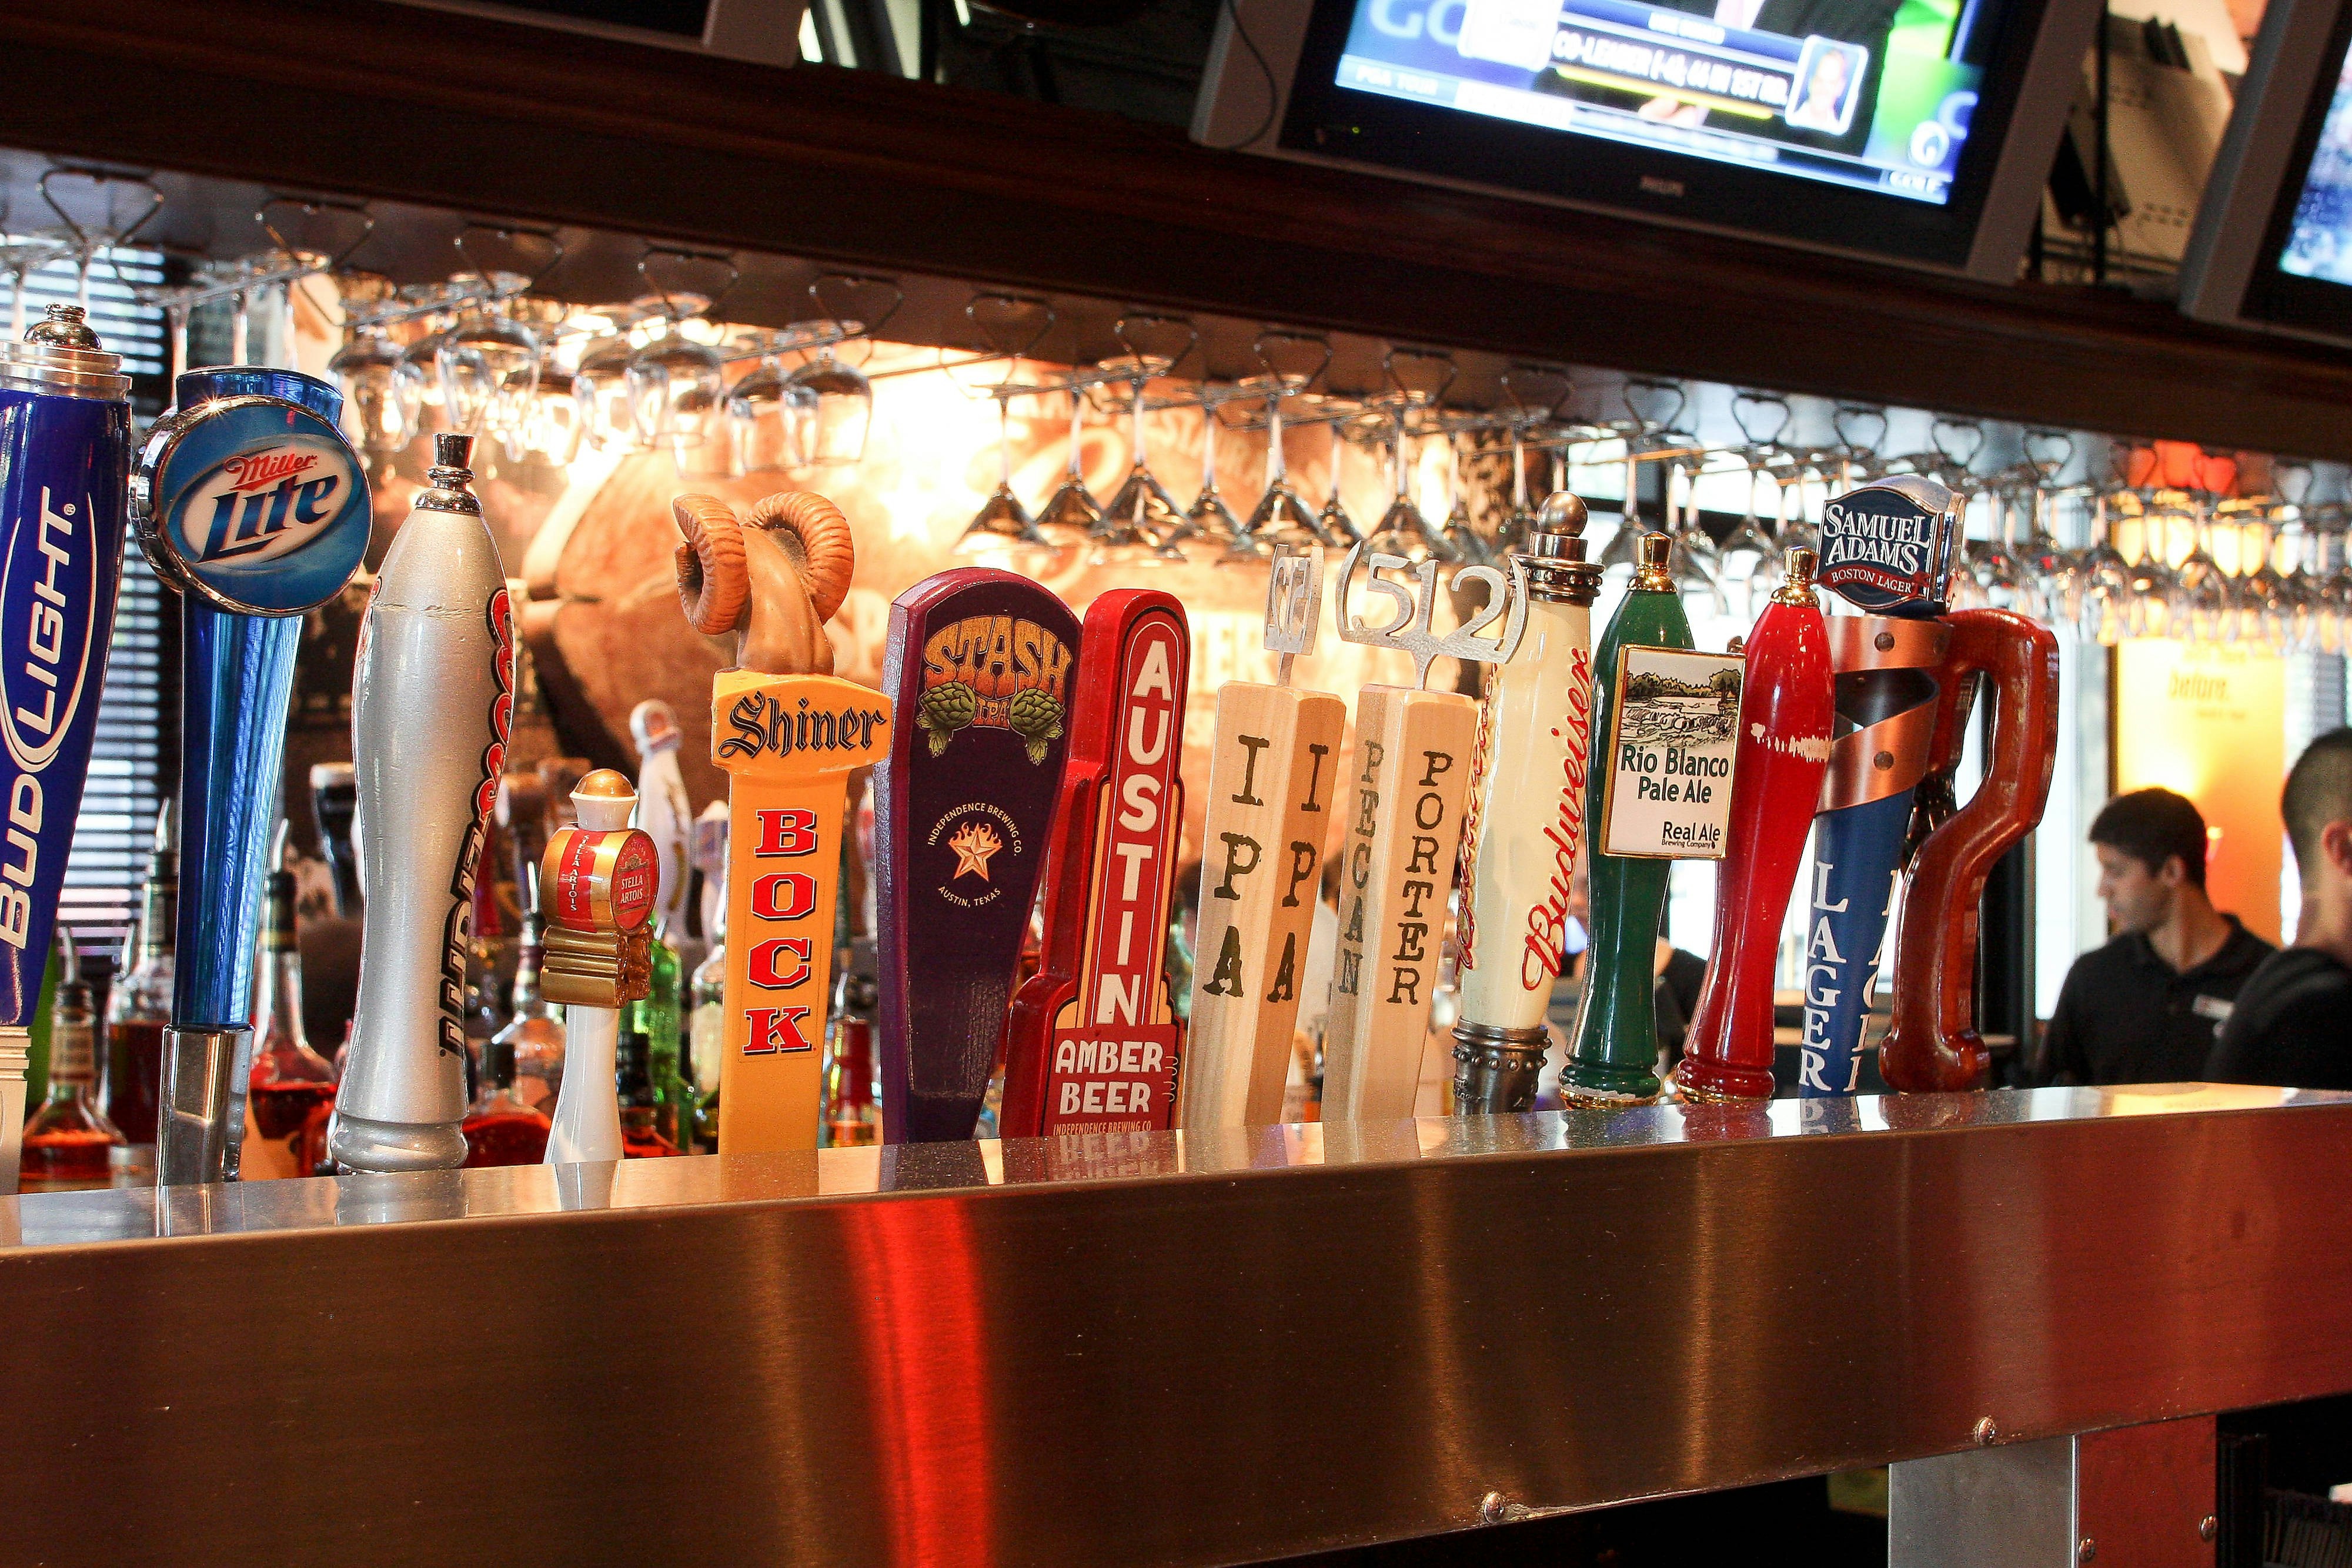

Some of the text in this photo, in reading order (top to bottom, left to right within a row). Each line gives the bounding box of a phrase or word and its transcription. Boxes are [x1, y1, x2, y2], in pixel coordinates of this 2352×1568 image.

[223, 453, 318, 486] Miller
[196, 474, 340, 563] Lite
[1823, 504, 1930, 549] SAMUEL
[1825, 536, 1919, 574] ADAMS
[1335, 540, 1529, 664] (512)
[1831, 568, 1912, 594] BOSTON LAGER
[924, 615, 1073, 706] STASH
[0, 486, 74, 950] BUD LIGHT
[718, 690, 888, 759] Shiner
[973, 696, 1010, 730] IPA
[1621, 745, 1729, 777] Rio Blanco
[1638, 776, 1712, 803] Pale Ale
[928, 803, 1022, 856] INDEPENDENCE BREWING CO.
[1097, 640, 1172, 1027] AUSTIN
[1521, 648, 1591, 991] Budweiser
[1661, 840, 1685, 848] Brewing
[1662, 821, 1720, 841] Real Ale
[569, 835, 589, 911] STELLA ARTOIS
[621, 875, 643, 890] STELLA
[1203, 734, 1269, 998] IPA
[1267, 743, 1329, 1003] IPA
[1339, 739, 1384, 996] PECAN
[1387, 751, 1453, 1005] PORTER
[620, 888, 643, 904] ARTOIS
[938, 886, 1001, 908] AUSTIN, TEXAS
[743, 808, 817, 1053] BOCK
[1799, 861, 1848, 1092] LAGER
[1055, 1039, 1163, 1074] AMBER
[1060, 1081, 1151, 1115] BEER
[1054, 1122, 1107, 1136] INDEPENDENCE
[1108, 1121, 1140, 1133] BREWING
